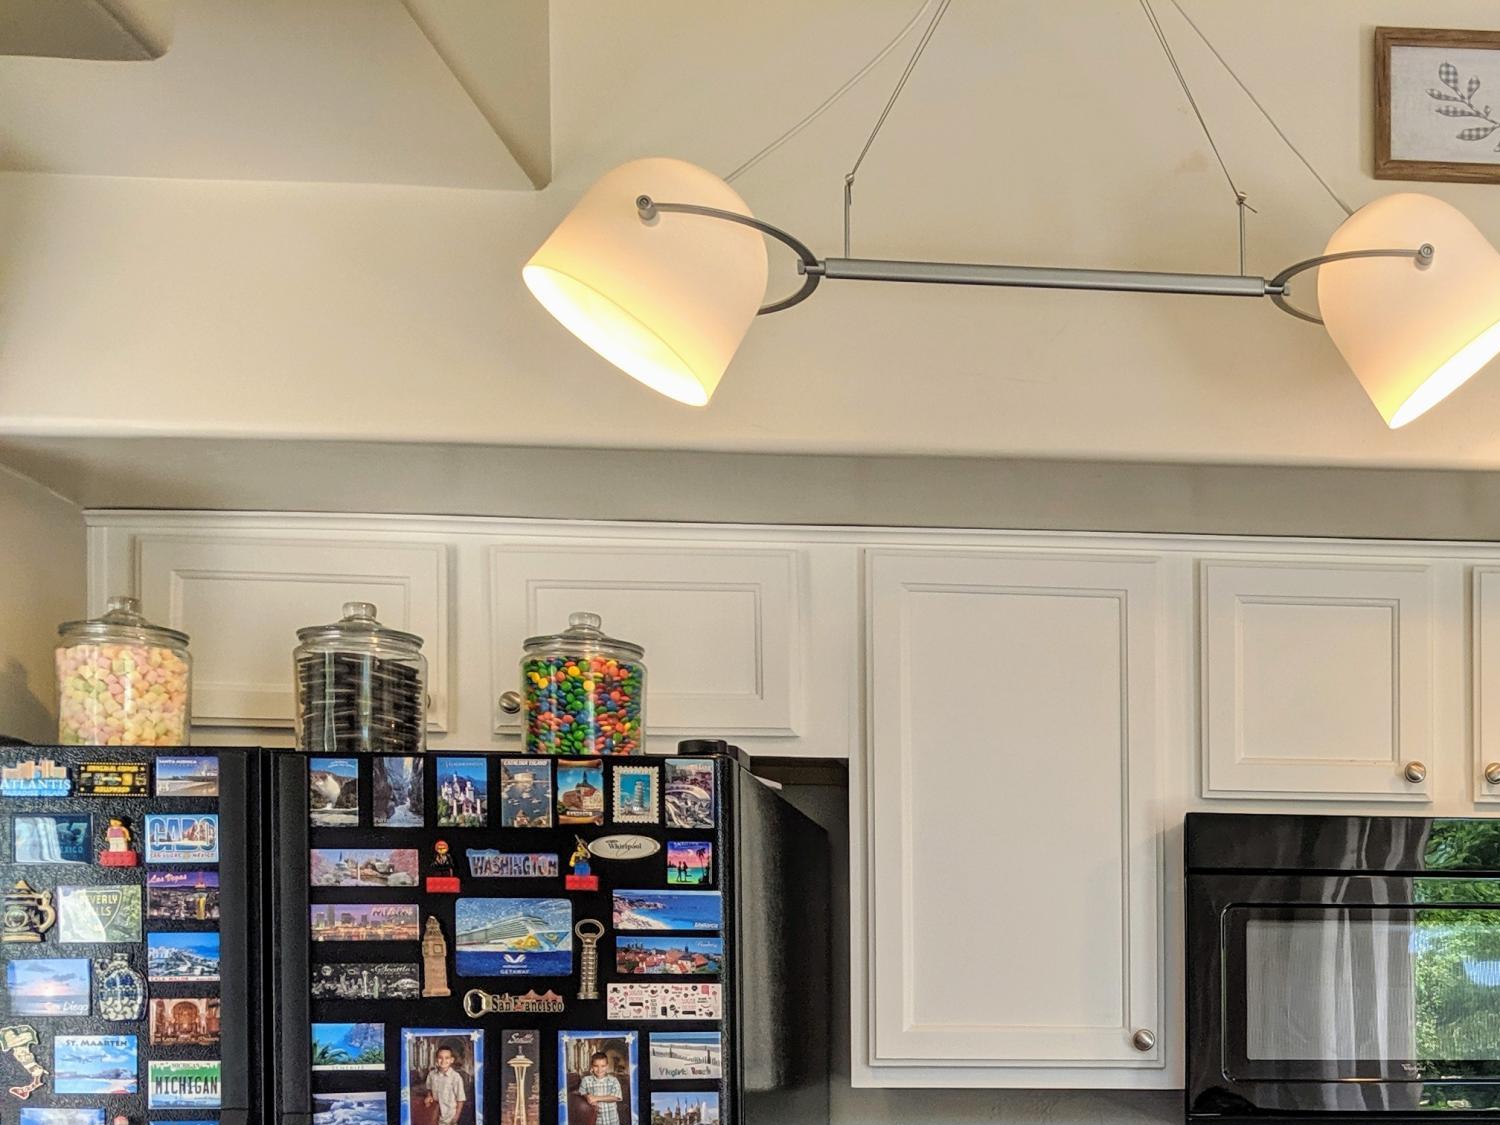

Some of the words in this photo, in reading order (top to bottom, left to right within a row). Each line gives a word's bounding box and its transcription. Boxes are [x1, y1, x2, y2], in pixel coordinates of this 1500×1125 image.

[0, 778, 71, 790] ATLANTIS
[148, 816, 216, 852] CABO
[608, 841, 642, 852] Whirlpool
[473, 856, 558, 876] WASHINGTON
[150, 874, 164, 883] Las
[165, 873, 187, 883] Vegas
[79, 893, 118, 903] VERLY
[63, 1000, 89, 1012] Diego
[491, 995, 511, 1011] San
[511, 995, 565, 1012] Francisco
[65, 1039, 77, 1047] ST.
[80, 1039, 127, 1047] MAARTEN
[155, 1076, 218, 1095] MICHIGAN
